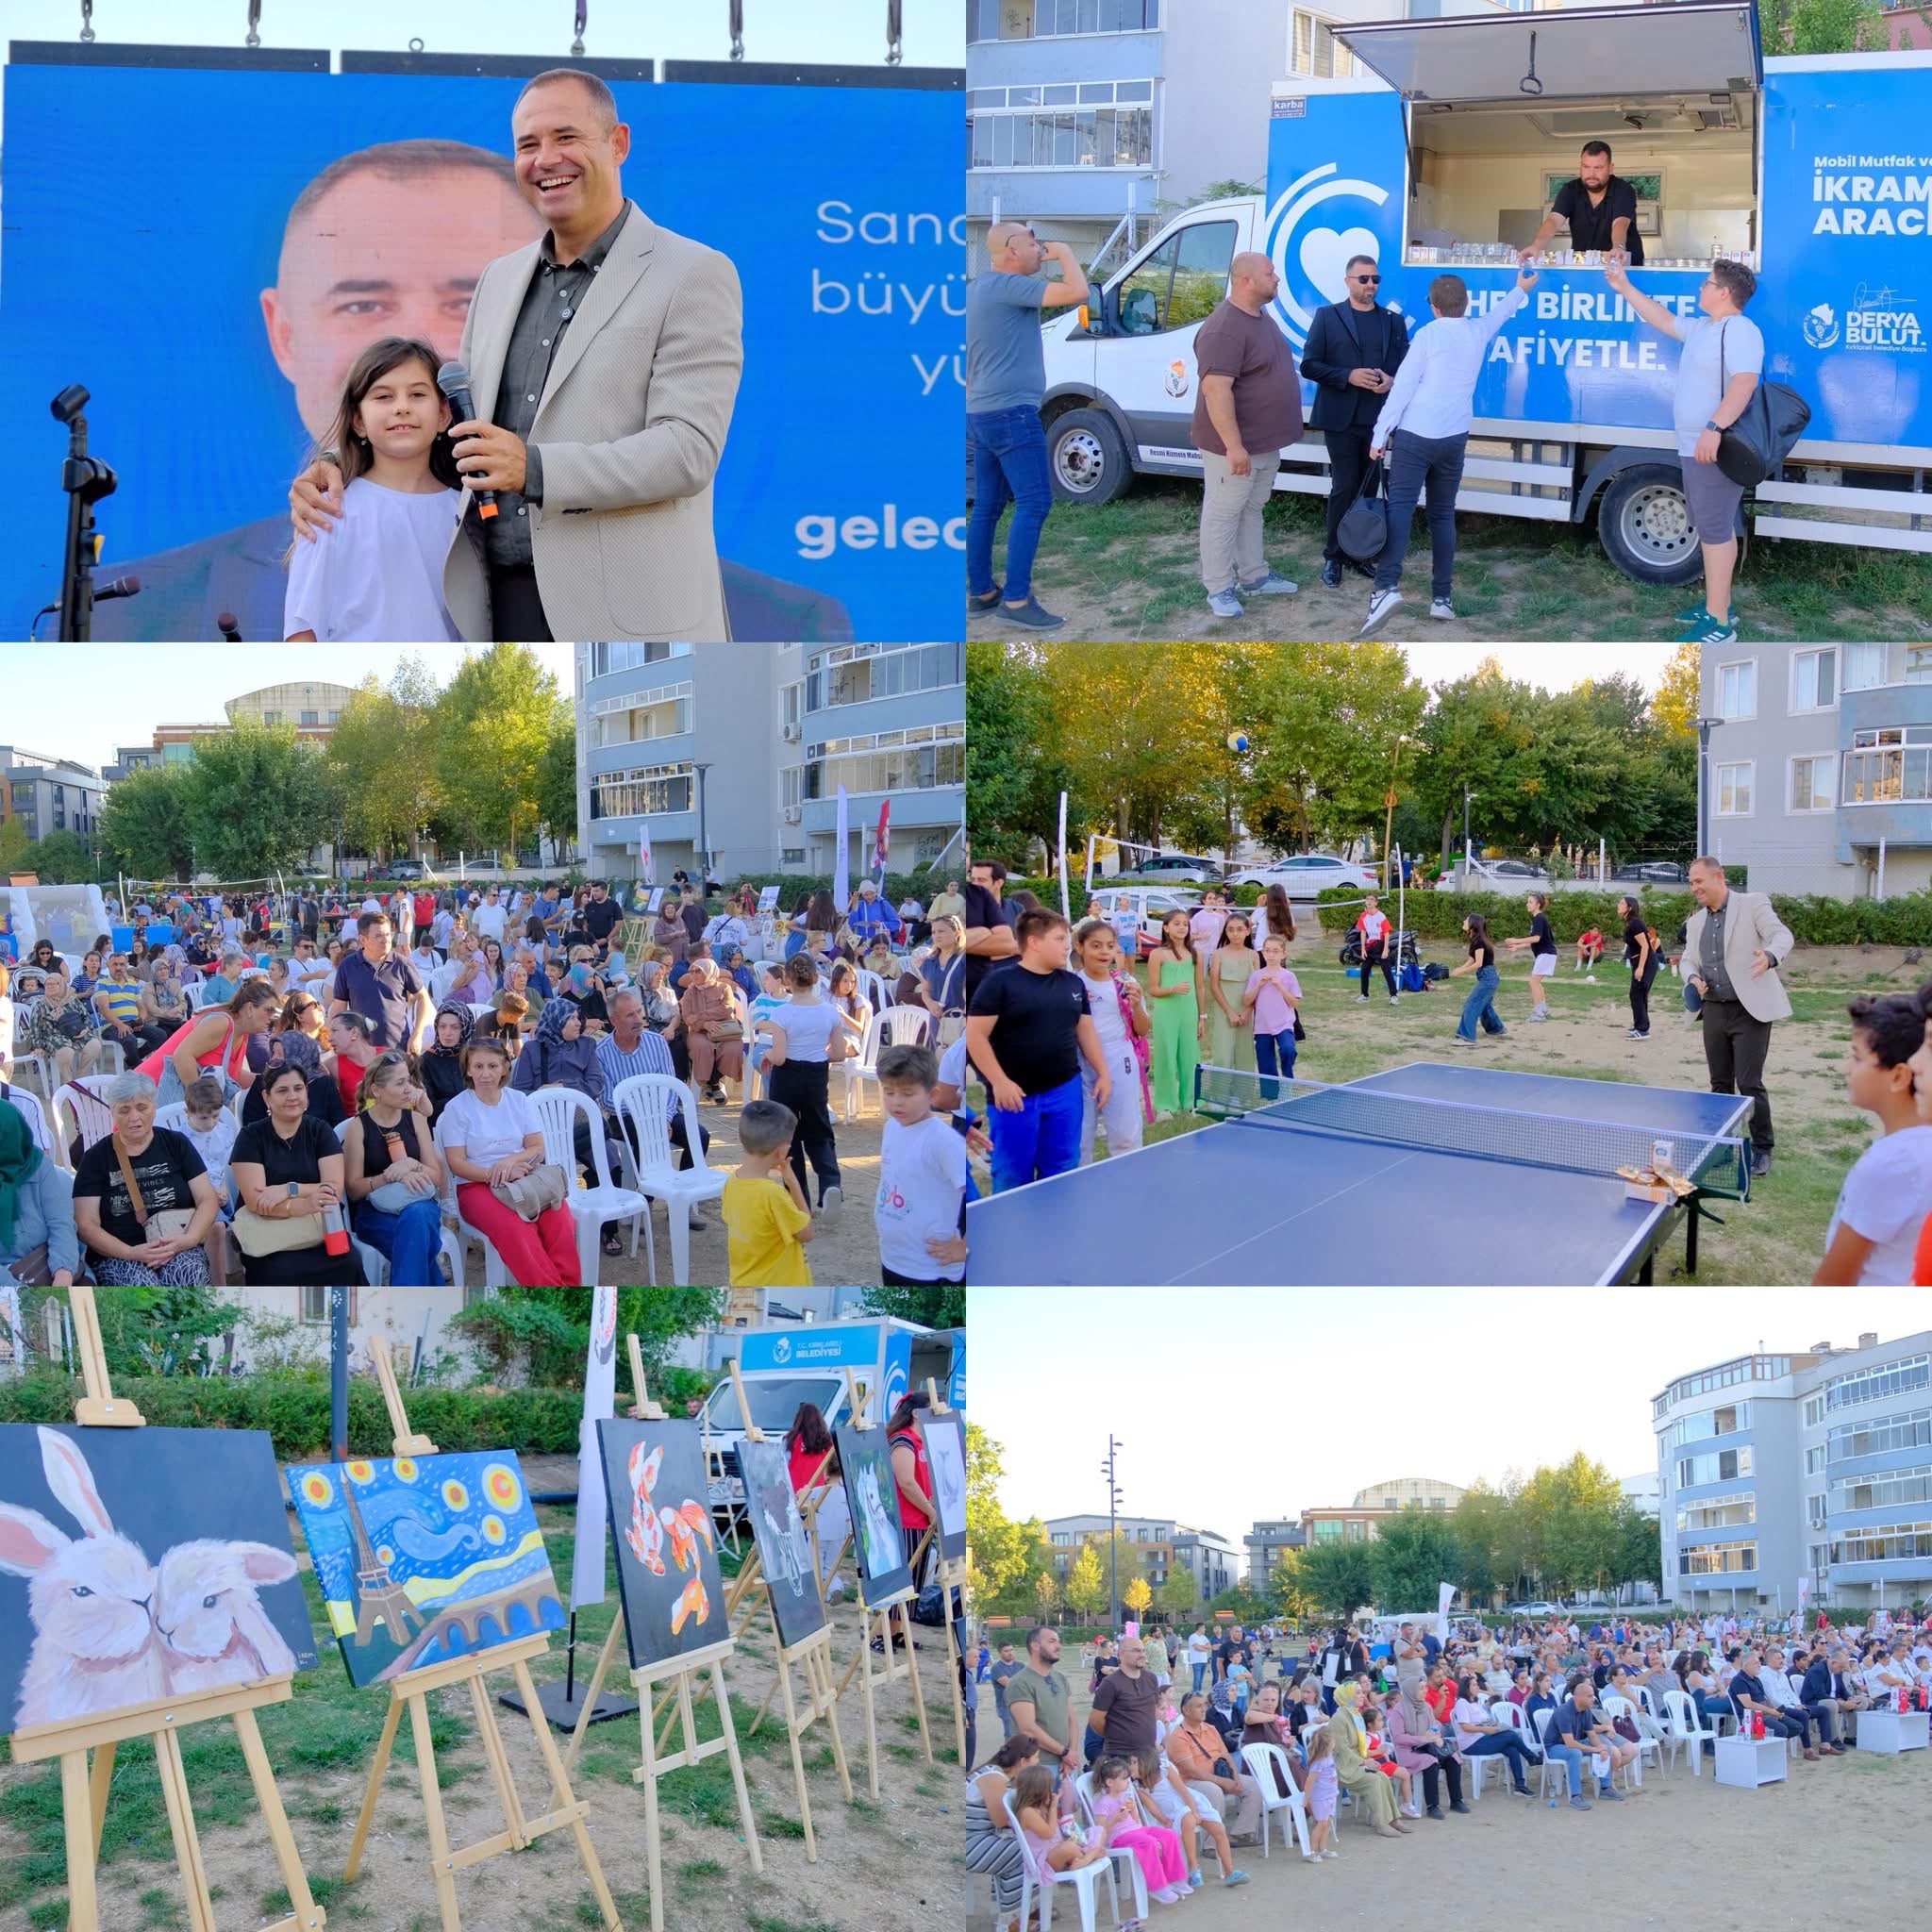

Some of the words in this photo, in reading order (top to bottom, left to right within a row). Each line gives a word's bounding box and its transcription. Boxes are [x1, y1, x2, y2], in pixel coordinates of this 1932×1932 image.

[1274, 100, 1304, 109] karba
[1814, 155, 1857, 168] Mobil
[1859, 155, 1916, 168] Mutfak
[1813, 169, 1932, 202] İKRAM
[1846, 311, 1920, 328] DERYA
[1488, 329, 1667, 371] AFİYETLE.
